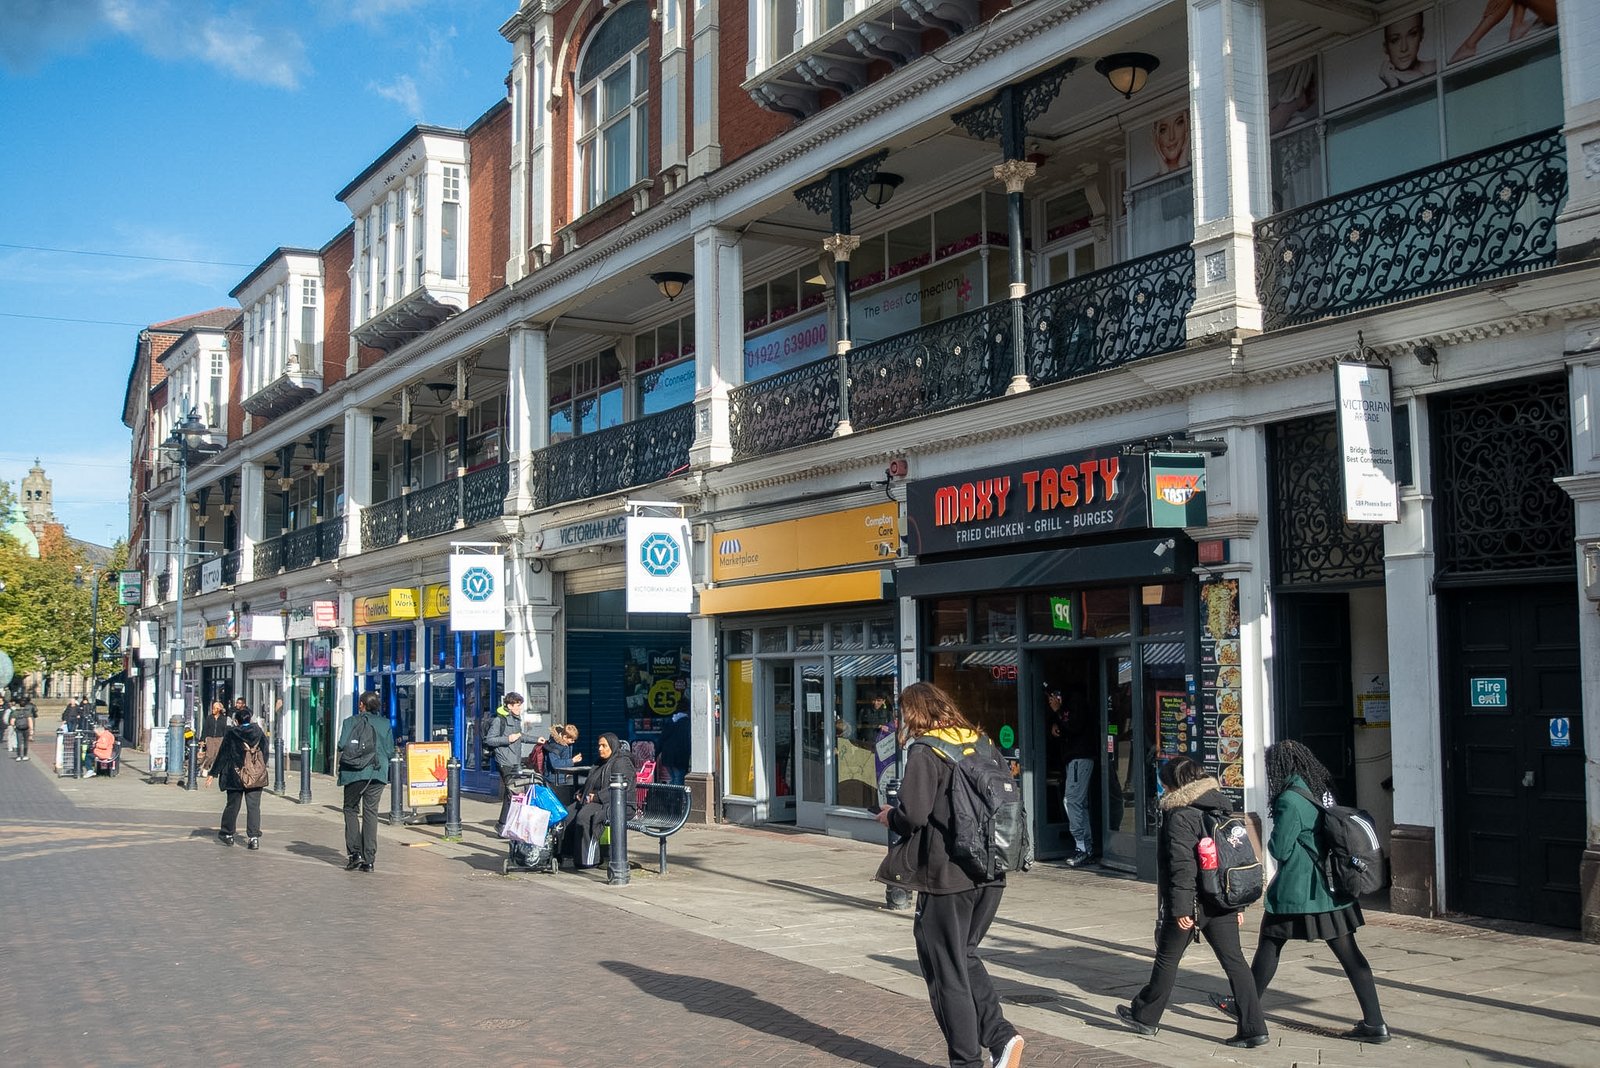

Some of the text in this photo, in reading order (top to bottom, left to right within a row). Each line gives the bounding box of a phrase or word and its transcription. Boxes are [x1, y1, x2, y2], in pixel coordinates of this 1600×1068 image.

[864, 276, 960, 319] The Best Connection
[747, 323, 827, 369] 01922 639000
[1343, 398, 1390, 413] VICTORIAN
[1354, 412, 1380, 423] ARCADE
[1350, 446, 1388, 456] Bridge Dentist
[1347, 455, 1393, 465] Best Connections
[935, 456, 1120, 526] MAXY TASTY
[1156, 474, 1199, 499] MAXY
[1164, 488, 1193, 503] TASTY
[864, 512, 893, 528] Compton
[956, 527, 981, 544] FRIED
[984, 522, 1024, 541] CHICKEN
[1034, 518, 1062, 533] GRILL
[1073, 510, 1114, 528] BURGES
[560, 520, 604, 545] VICTORIAN
[878, 526, 893, 537] Care
[720, 552, 759, 567] Marketplace
[395, 600, 417, 608] Works
[1477, 681, 1501, 692] Fire
[654, 691, 676, 708] £5
[1478, 693, 1501, 704] exit
